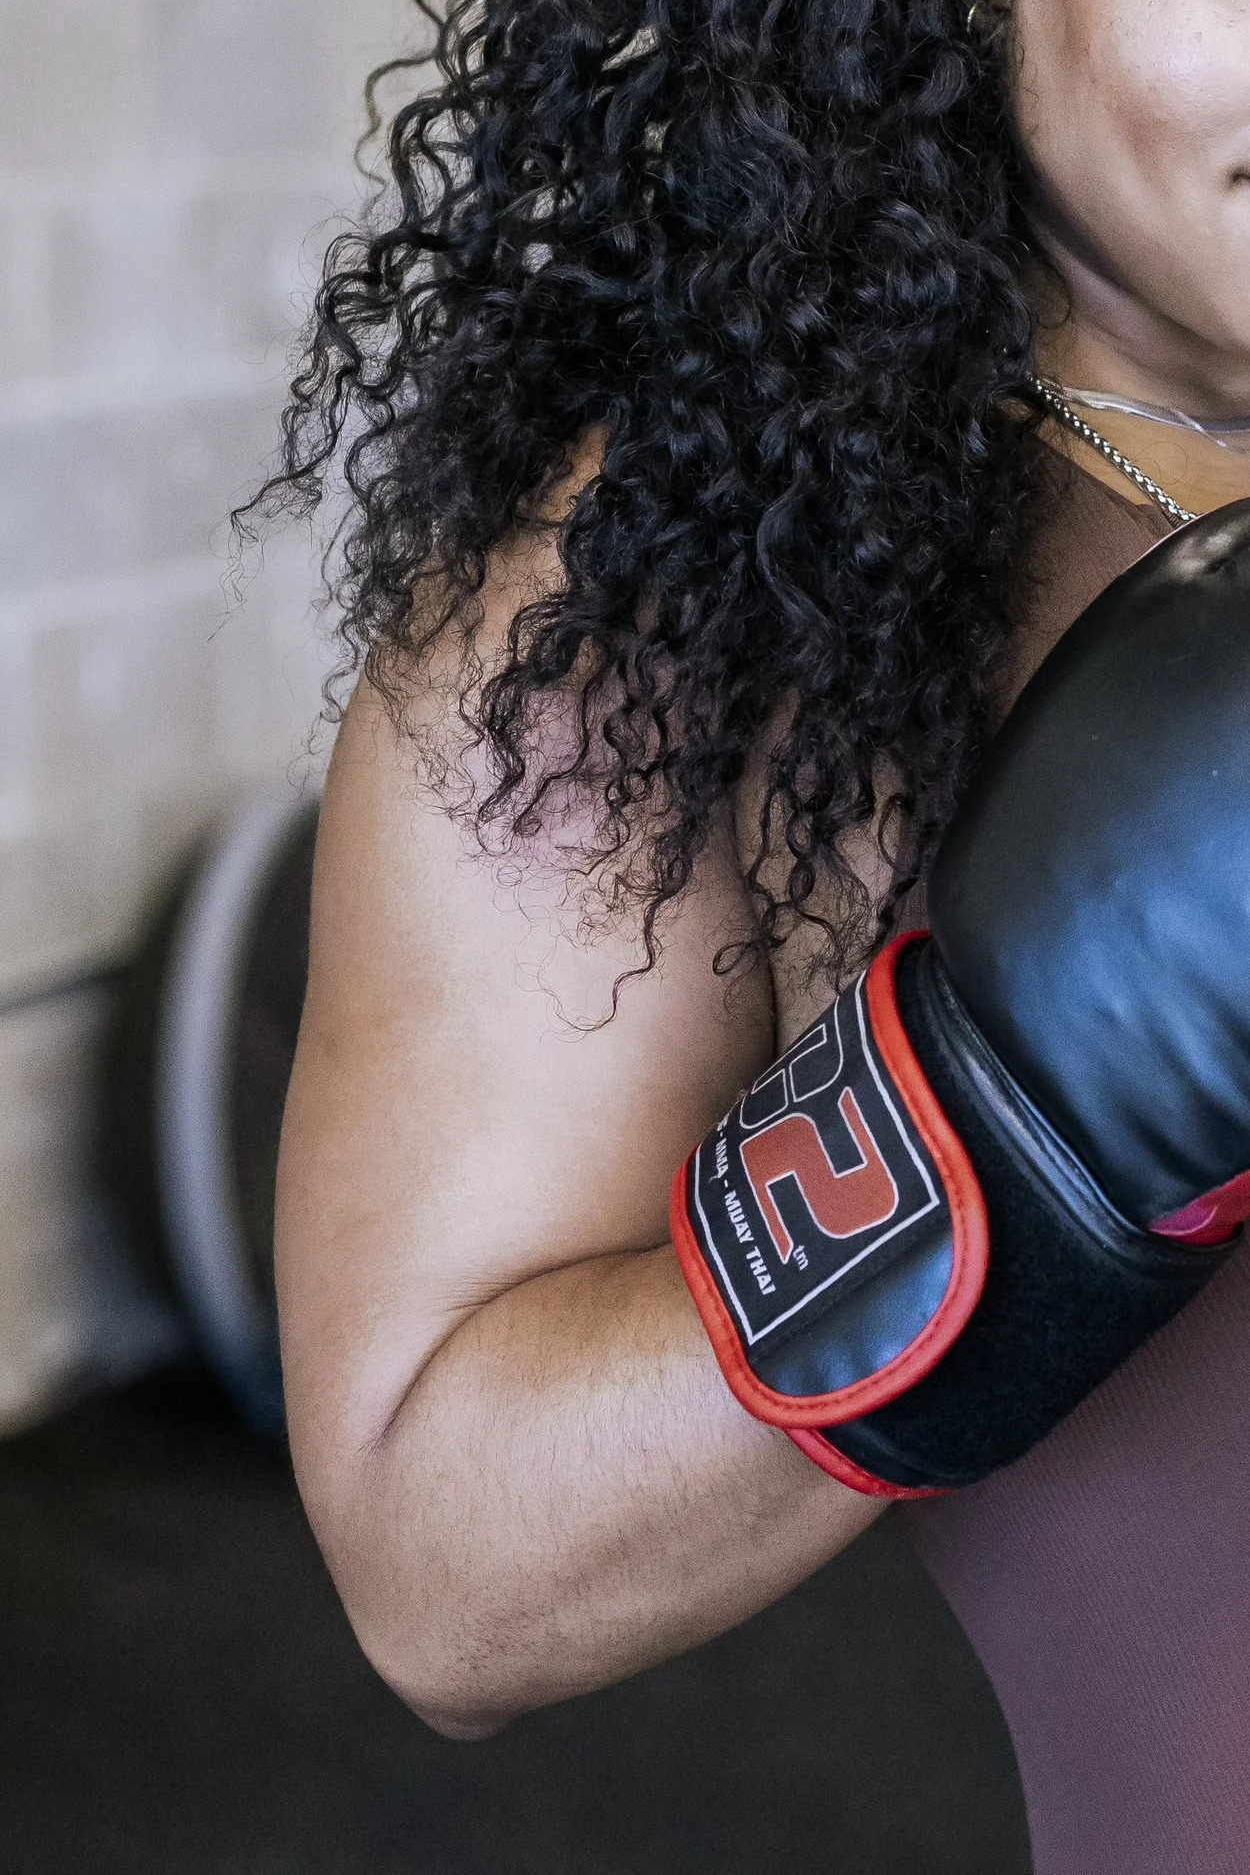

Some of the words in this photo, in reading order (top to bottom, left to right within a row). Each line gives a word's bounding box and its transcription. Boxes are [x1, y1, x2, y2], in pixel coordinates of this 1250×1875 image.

[715, 1137, 729, 1179] MMA
[724, 1190, 755, 1243] MUAY
[746, 1246, 777, 1295] THAI
